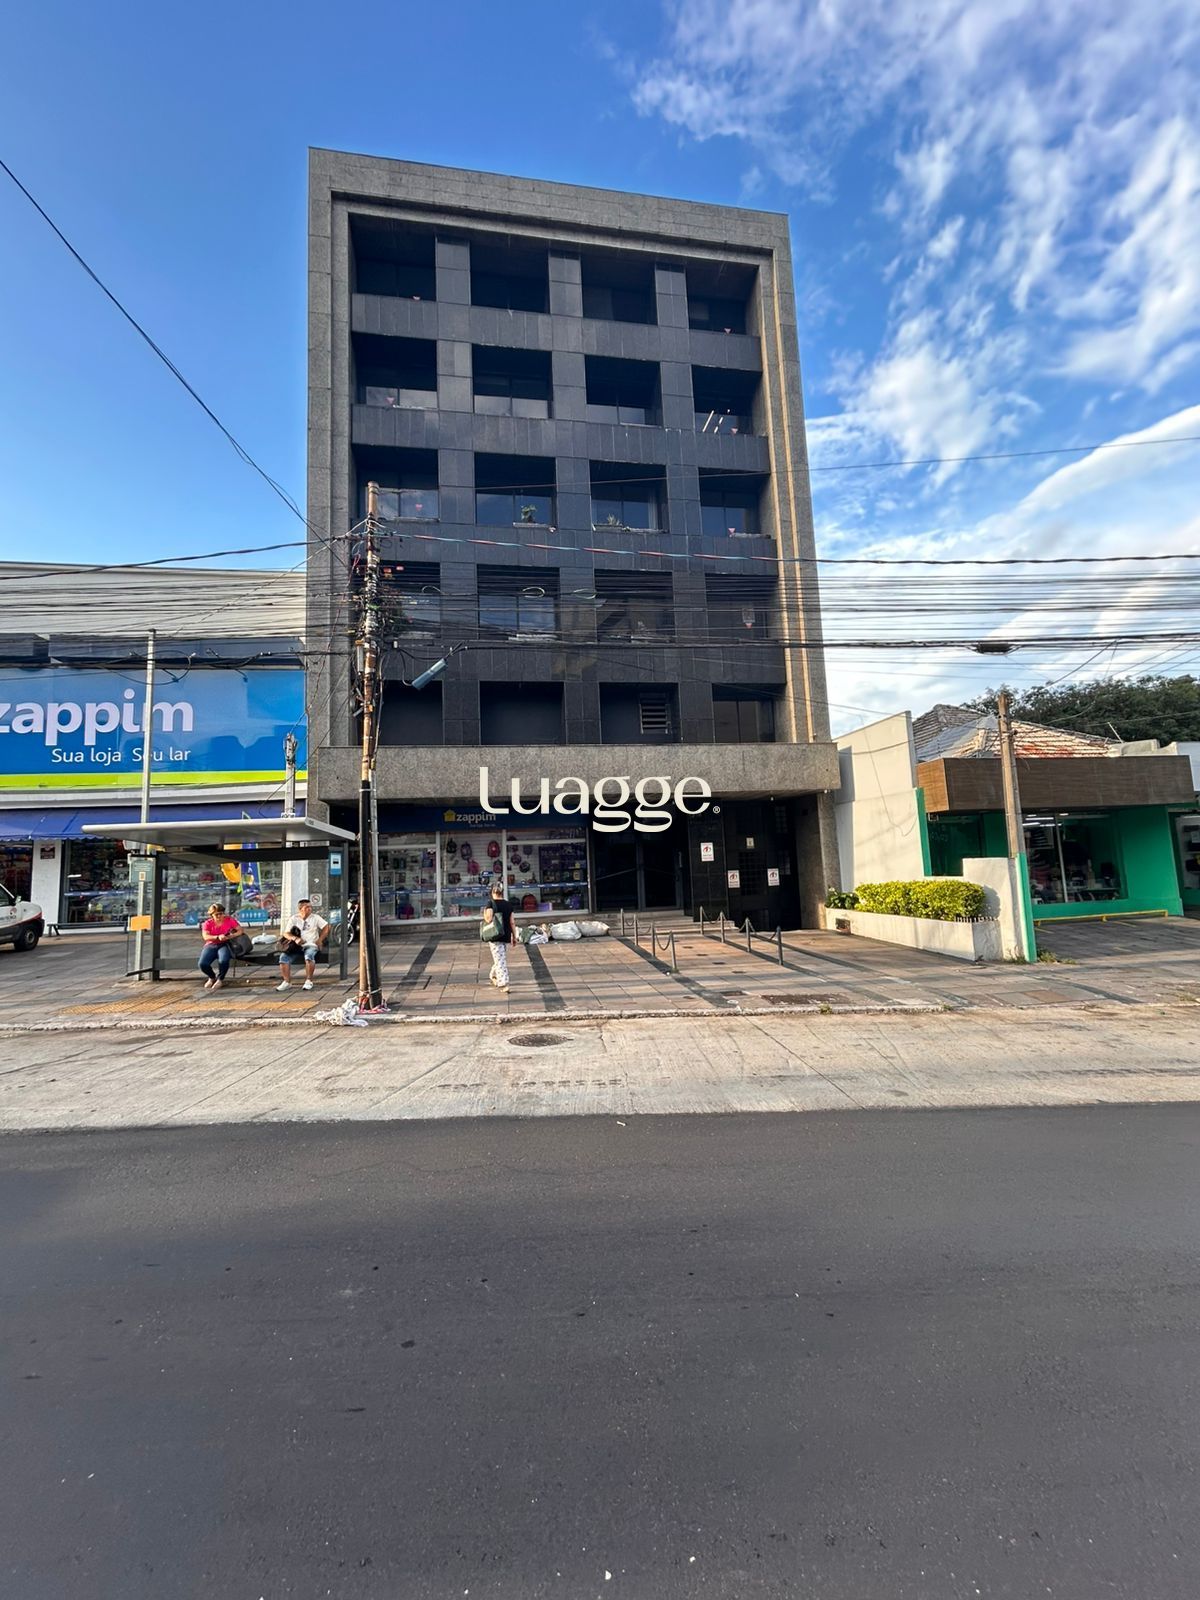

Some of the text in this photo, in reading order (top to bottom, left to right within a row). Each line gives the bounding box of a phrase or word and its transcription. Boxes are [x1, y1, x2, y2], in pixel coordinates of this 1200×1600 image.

[51, 748, 84, 763] Sua
[90, 747, 122, 766] loja
[169, 746, 192, 761] lar
[456, 811, 496, 824] zappim
